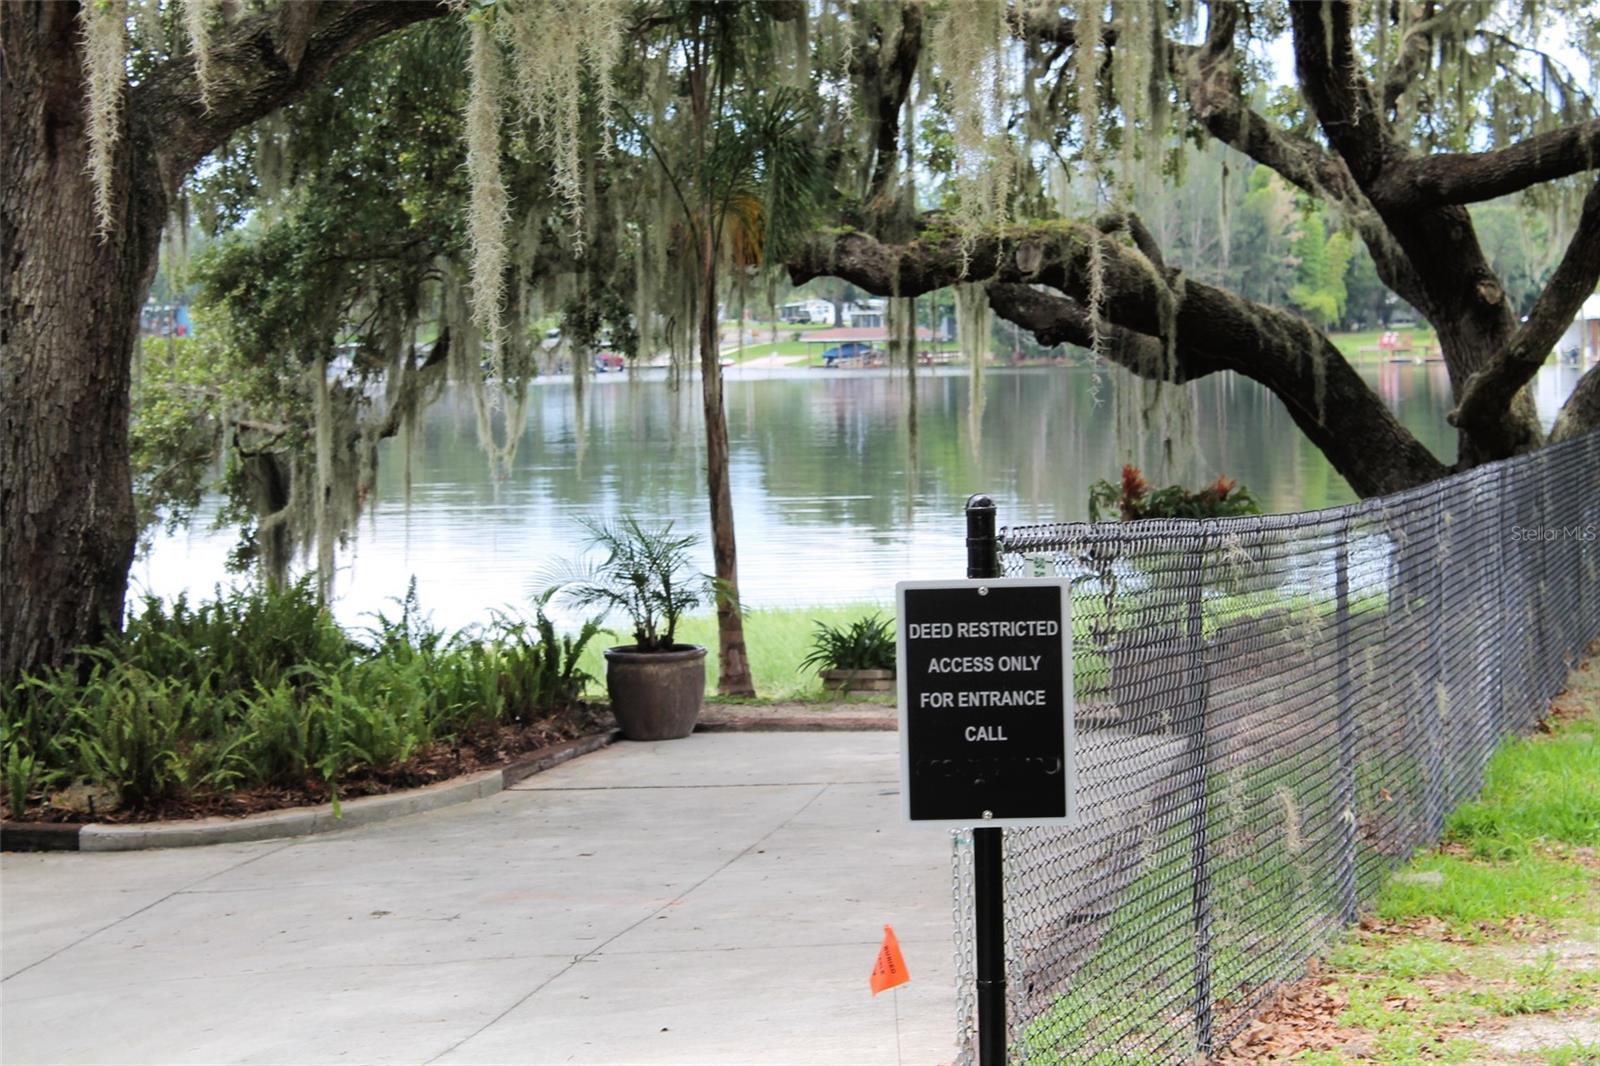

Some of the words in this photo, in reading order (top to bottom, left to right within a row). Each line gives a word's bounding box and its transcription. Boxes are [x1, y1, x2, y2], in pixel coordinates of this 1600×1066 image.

[909, 623, 953, 639] DEED
[957, 620, 1059, 638] RESTRICTED
[928, 657, 994, 673] ACCESS
[998, 655, 1041, 671] ONLY
[920, 692, 954, 708] FOR
[958, 690, 1046, 707] ENTRANCE
[965, 726, 1008, 741] CALL
